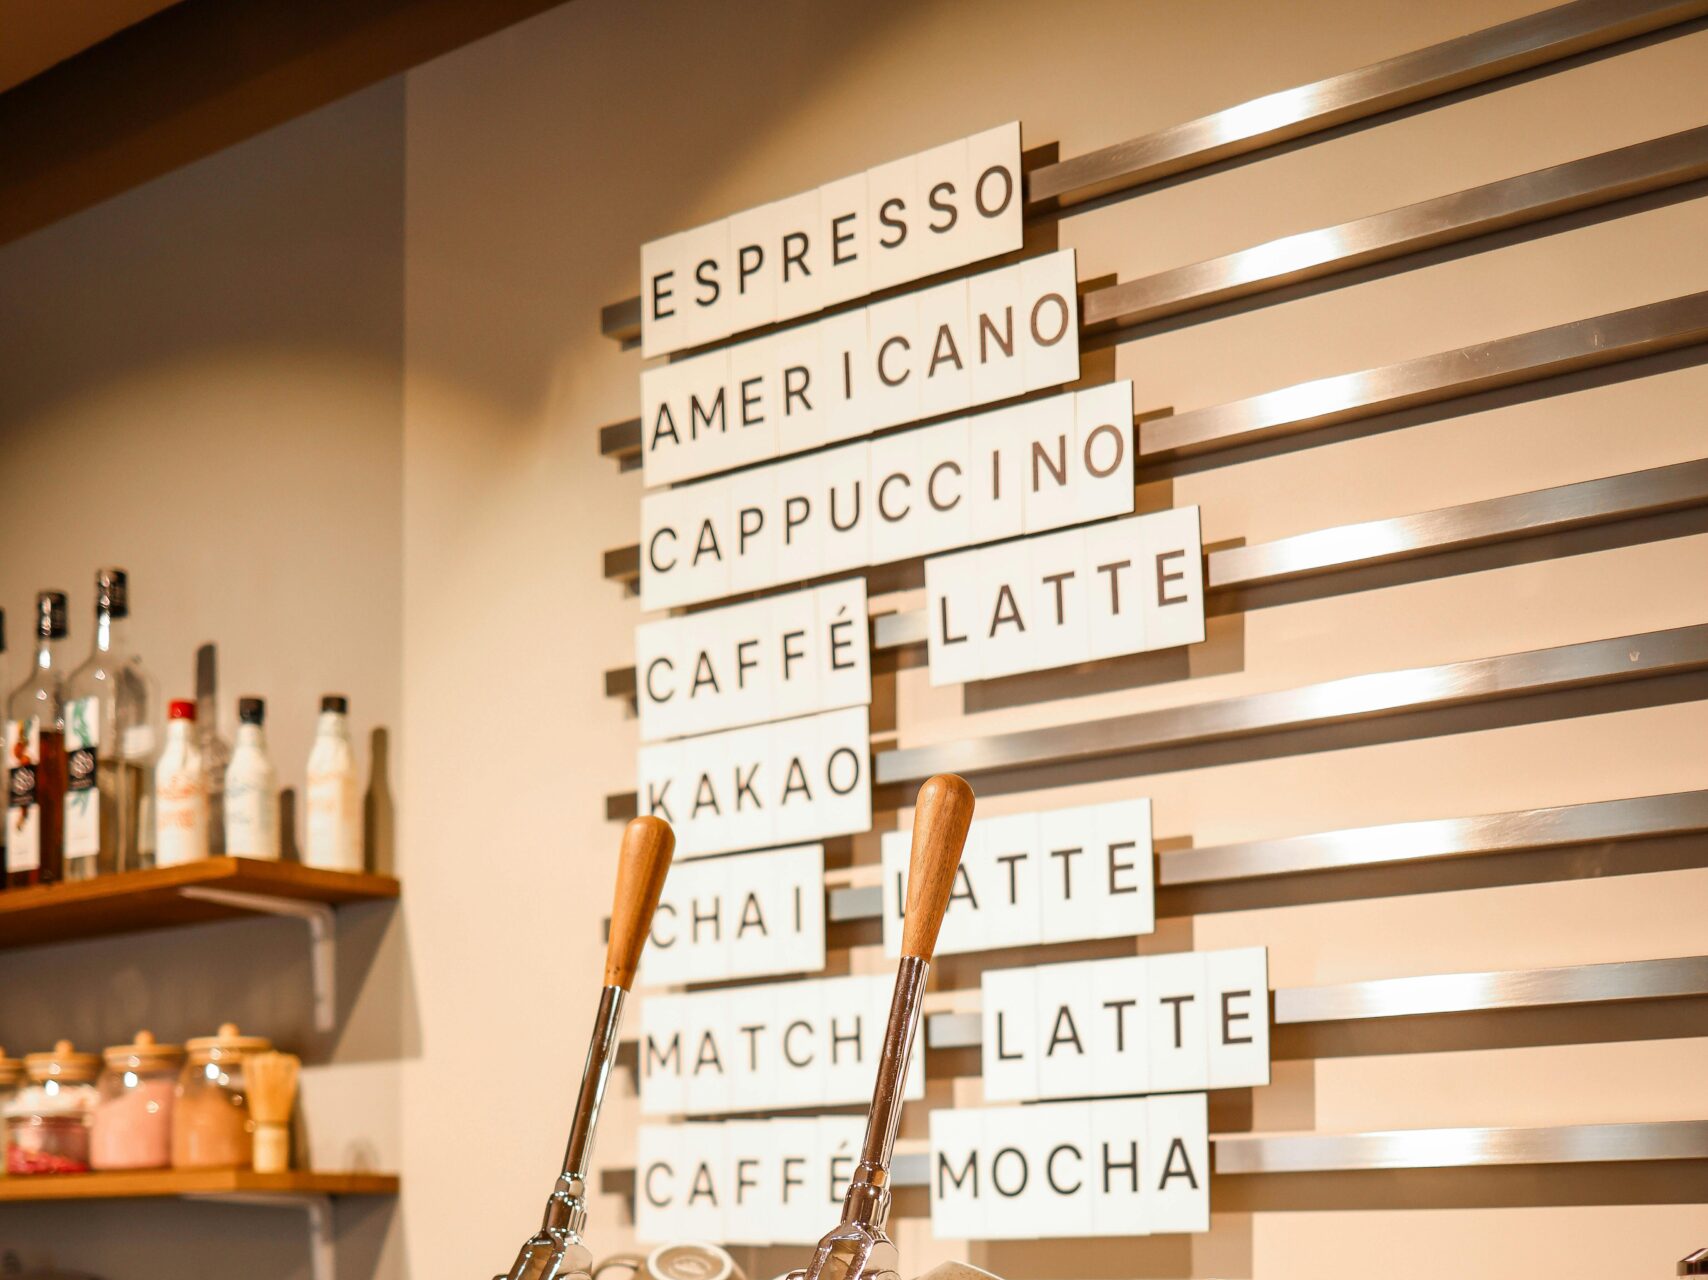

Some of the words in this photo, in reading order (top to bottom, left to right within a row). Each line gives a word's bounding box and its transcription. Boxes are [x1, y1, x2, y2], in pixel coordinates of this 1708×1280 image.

[652, 165, 1013, 319] ESPRESSO
[650, 292, 1069, 450] AMERICANO
[649, 424, 1124, 573] CAPPUCCINO
[646, 607, 856, 703] CAFFÉ
[941, 549, 1189, 645] LATTE
[649, 747, 860, 821] KAKAO
[650, 886, 802, 949] CHAI
[897, 842, 1138, 918] LATTE
[647, 1016, 913, 1077] MATCH
[998, 990, 1253, 1061] LATTE
[645, 1142, 854, 1208] CAFFÉ
[939, 1136, 1199, 1199] MOCHA
